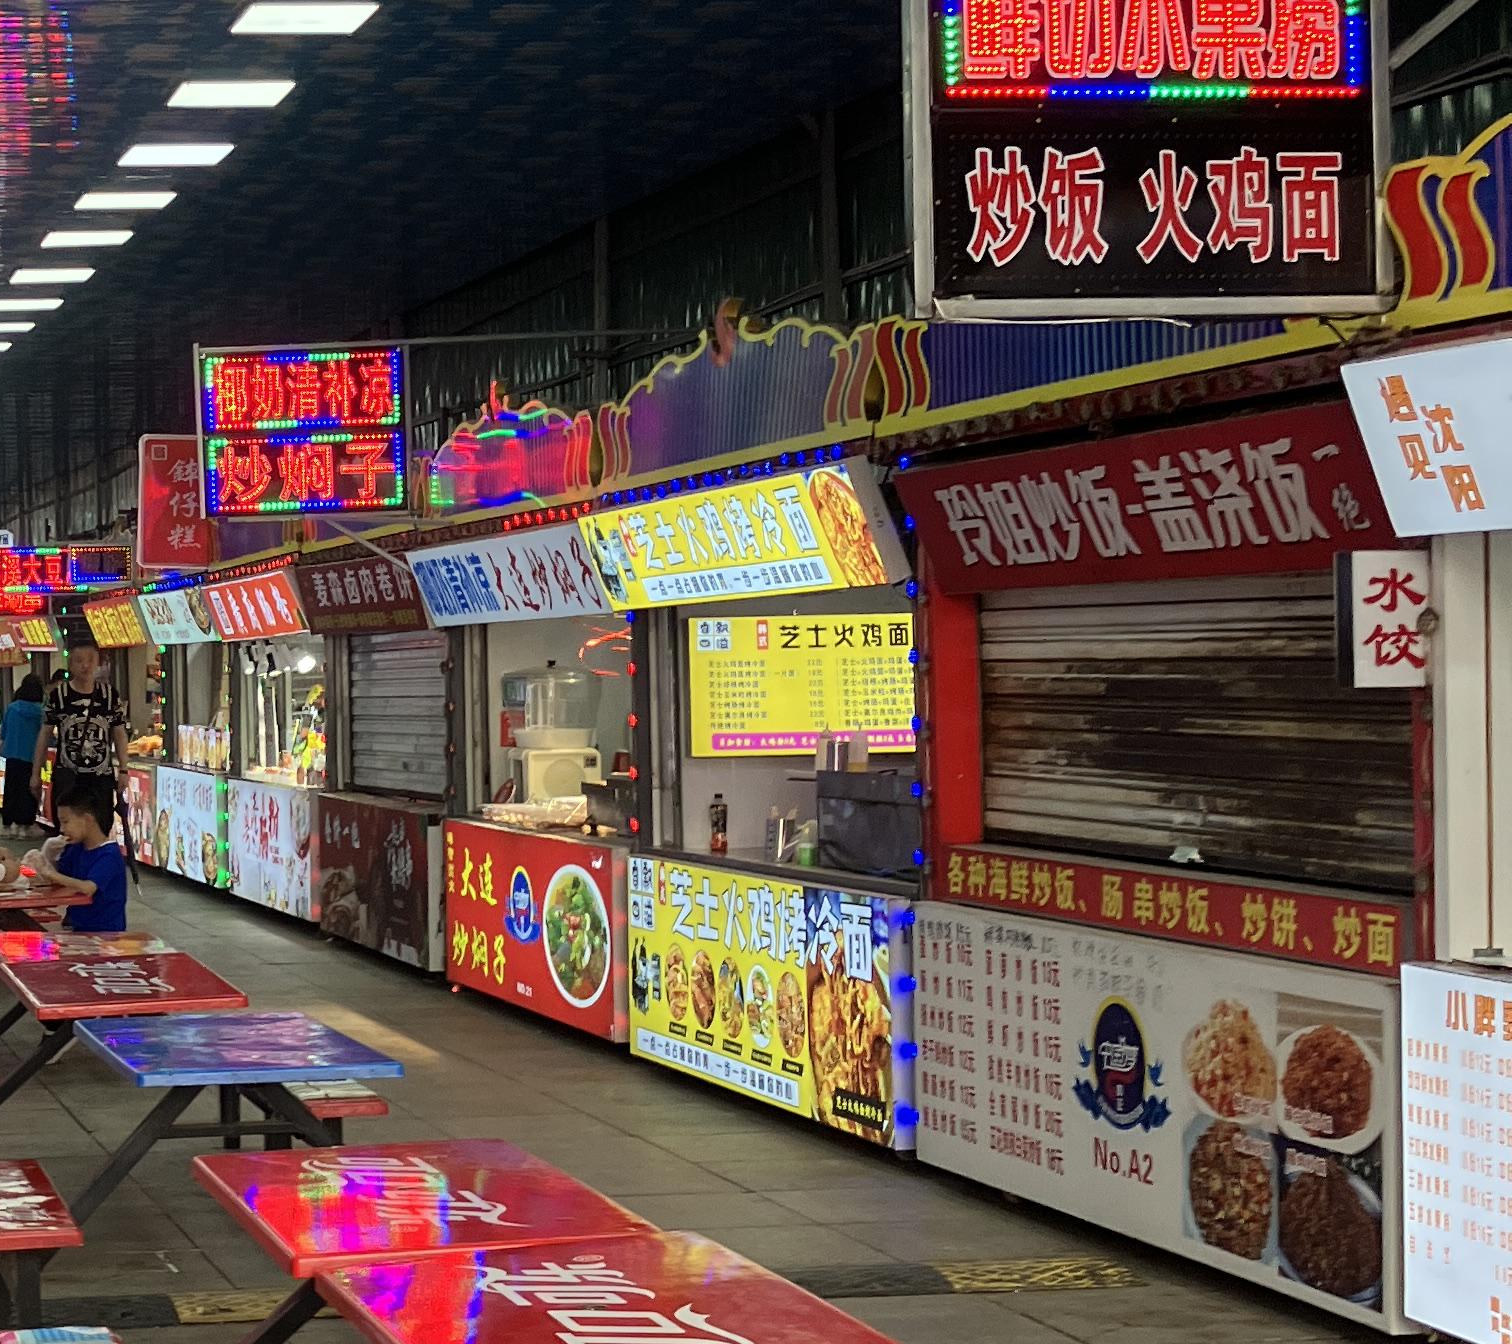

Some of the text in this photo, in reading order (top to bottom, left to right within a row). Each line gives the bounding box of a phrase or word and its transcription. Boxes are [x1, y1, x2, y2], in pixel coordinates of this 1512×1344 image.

[965, 145, 1342, 267] 炒饭 火鸡面
[215, 359, 394, 422] 椰奶清补凉
[217, 442, 395, 503] 炒焖子
[1420, 404, 1486, 513] 沈阳
[626, 485, 819, 571] 芝士火鸡烤冷面
[934, 438, 1332, 567] 玲姐炒饭-盖浇饭
[487, 535, 603, 612] 大连炒焖子
[778, 622, 910, 649] 芝士火鸡面
[1362, 567, 1426, 670] 水饺
[460, 847, 498, 906] 大连
[452, 919, 507, 985] 炒焖子
[669, 866, 874, 984] 芝士火鸡烤冷面
[1092, 1136, 1155, 1186] No.A2
